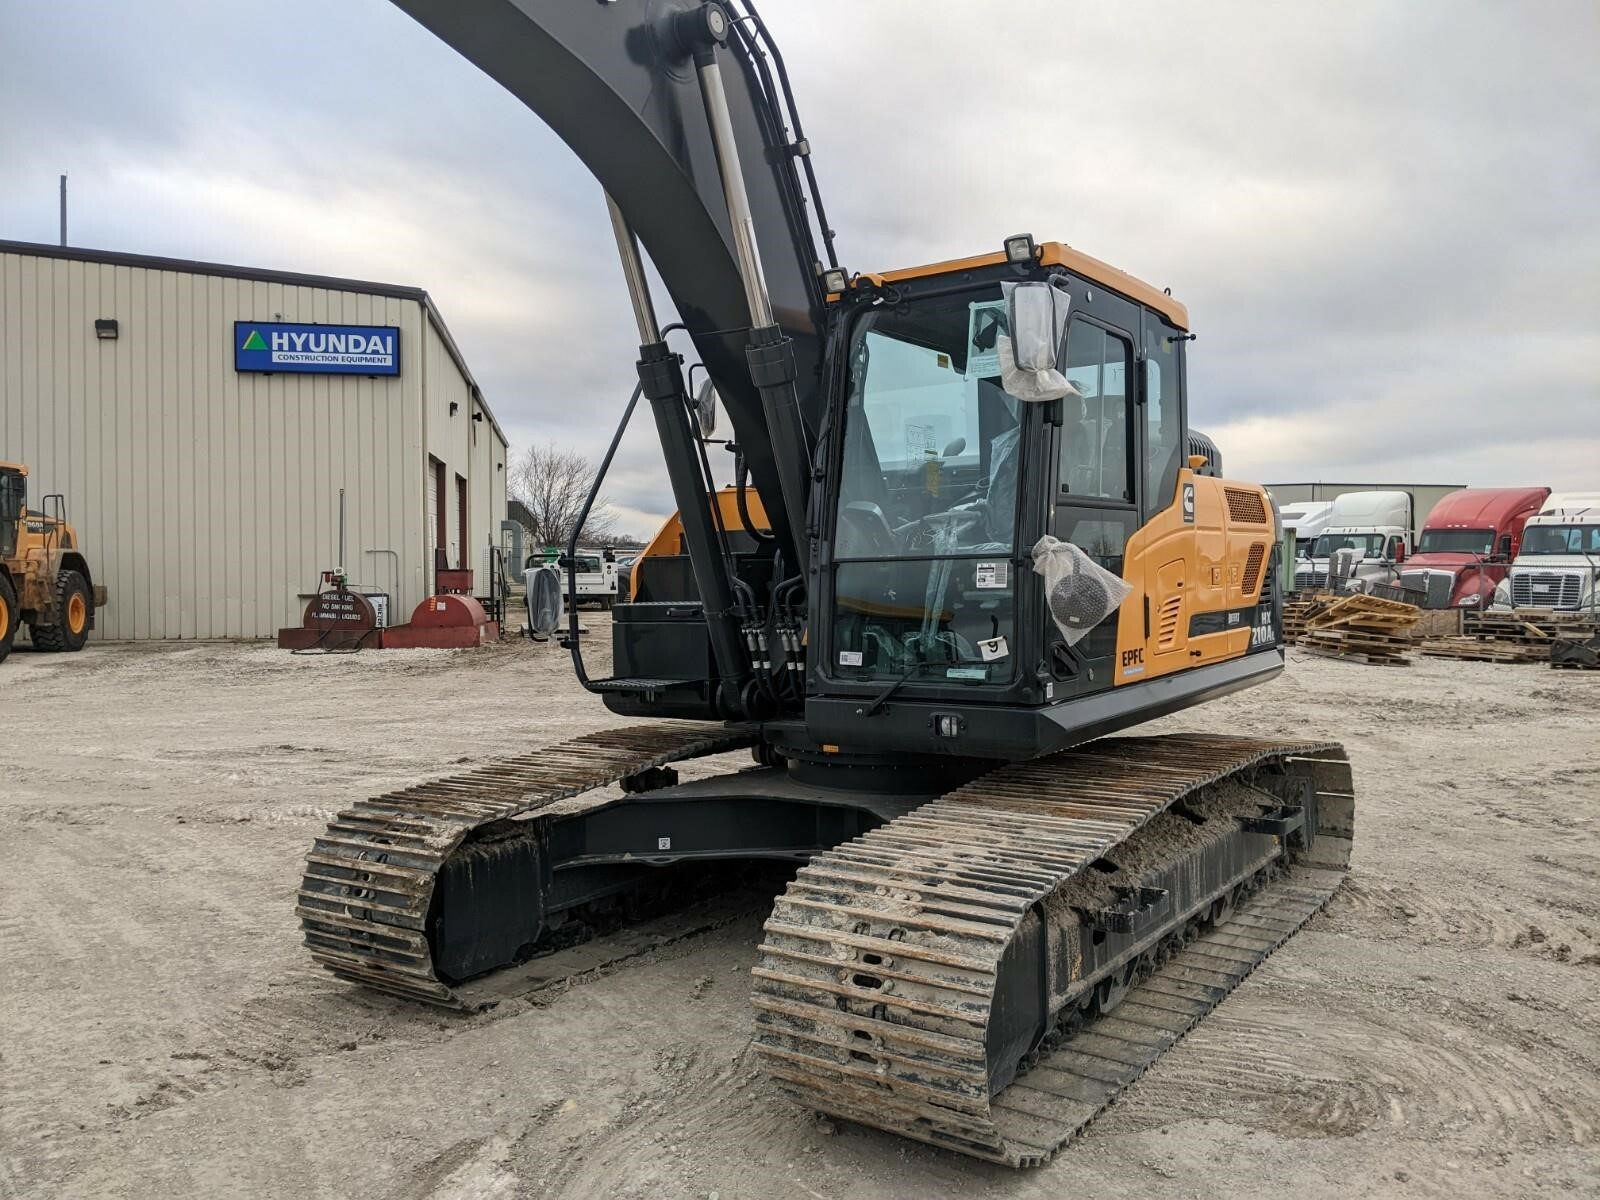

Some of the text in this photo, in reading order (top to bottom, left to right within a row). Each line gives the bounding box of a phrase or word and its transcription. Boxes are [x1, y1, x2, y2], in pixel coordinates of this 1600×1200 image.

[271, 331, 393, 355] HYUNDAI
[277, 353, 388, 364] CONSTRUCTION EQUIPMENT
[322, 593, 340, 601] DIESEL
[311, 611, 341, 619] FLMMABL
[1261, 611, 1272, 625] HX
[1122, 648, 1144, 667] EPFC
